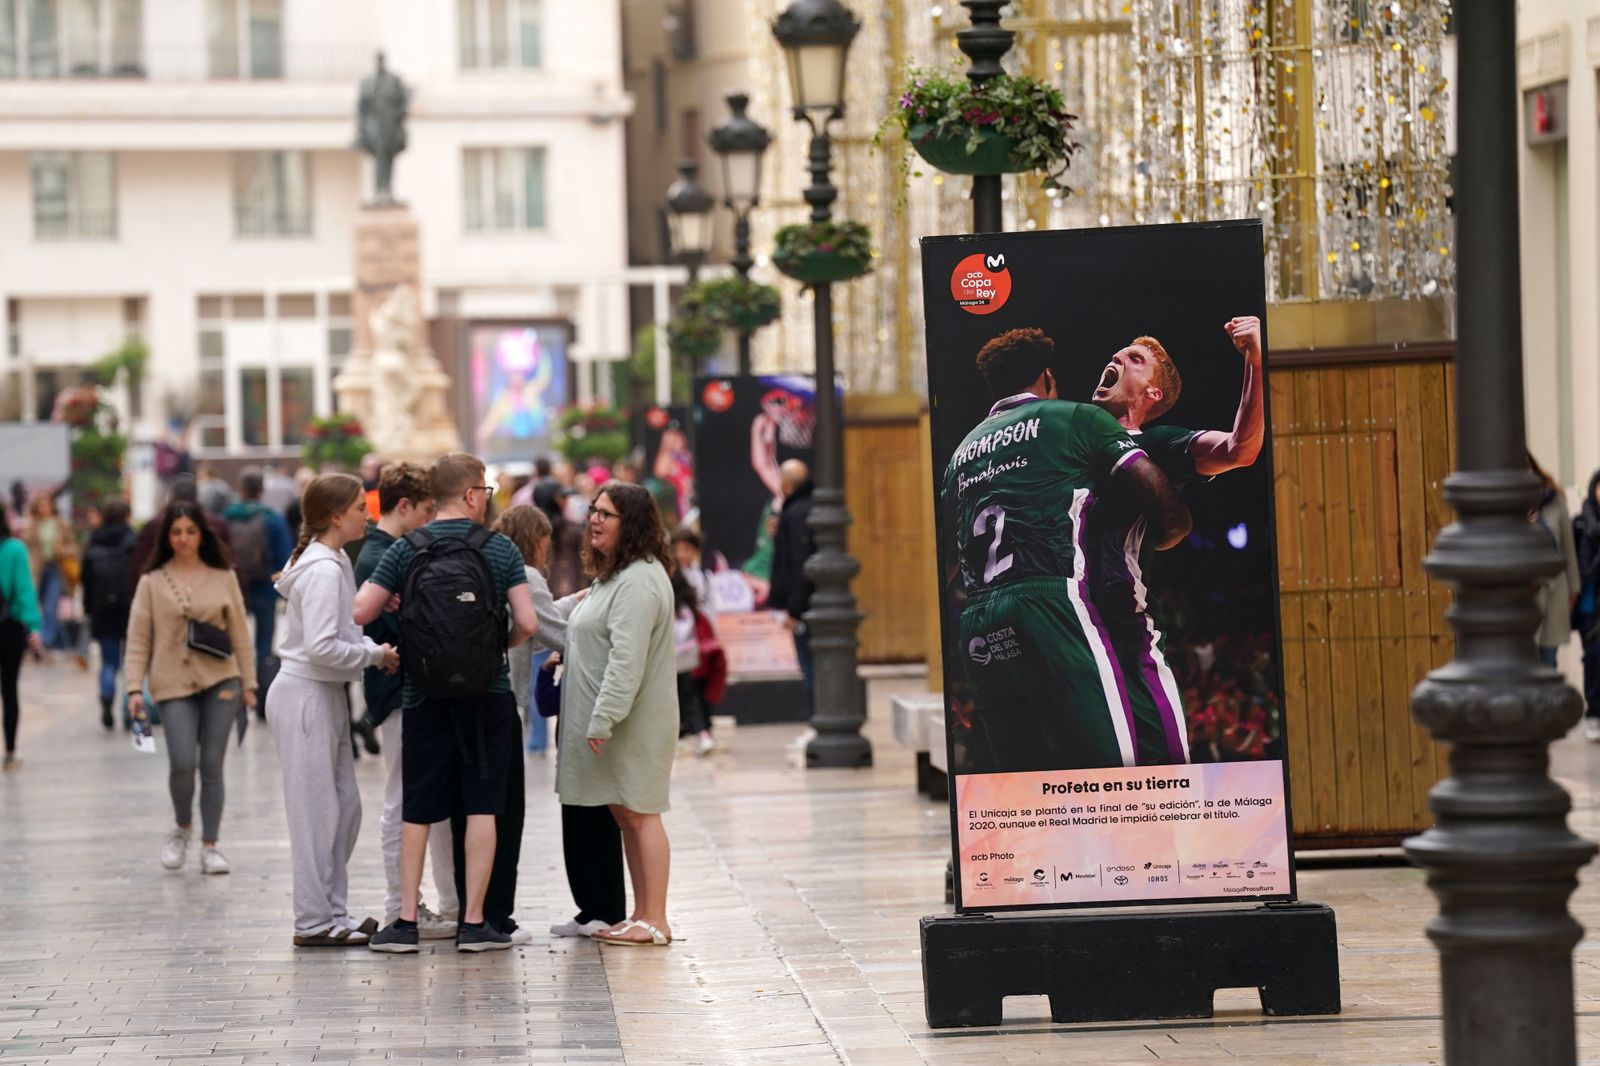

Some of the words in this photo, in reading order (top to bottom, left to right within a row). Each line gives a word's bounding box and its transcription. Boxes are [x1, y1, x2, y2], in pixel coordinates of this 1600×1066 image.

[961, 278, 992, 288] Copa
[976, 289, 996, 299] Rey
[953, 418, 1040, 470] THOMPSON
[973, 504, 1014, 584] 2
[986, 626, 1016, 643] COSTA
[990, 644, 1004, 653] DEL
[1003, 638, 1019, 649] SOL
[1042, 781, 1099, 794] Profeta
[1103, 782, 1122, 792] en
[1126, 780, 1142, 791] su
[1146, 776, 1190, 790] tierra
[969, 810, 977, 818] El
[981, 809, 1017, 820] Unicaja
[1035, 805, 1067, 818] plantó
[1087, 804, 1096, 813] la
[1100, 803, 1121, 812] final
[1125, 803, 1138, 811] de
[1204, 799, 1214, 808] la
[1217, 799, 1231, 808] de
[1235, 796, 1272, 806] Málaga
[969, 821, 997, 830] 2020,
[999, 820, 1036, 830] aunque
[1038, 819, 1047, 827] el
[1050, 817, 1070, 826] Real
[1073, 816, 1108, 825] Madrid
[1110, 815, 1119, 824] le
[1121, 813, 1158, 824] impidió
[1160, 812, 1201, 821] celebrar
[1203, 811, 1212, 820] el
[1214, 810, 1240, 819] título.
